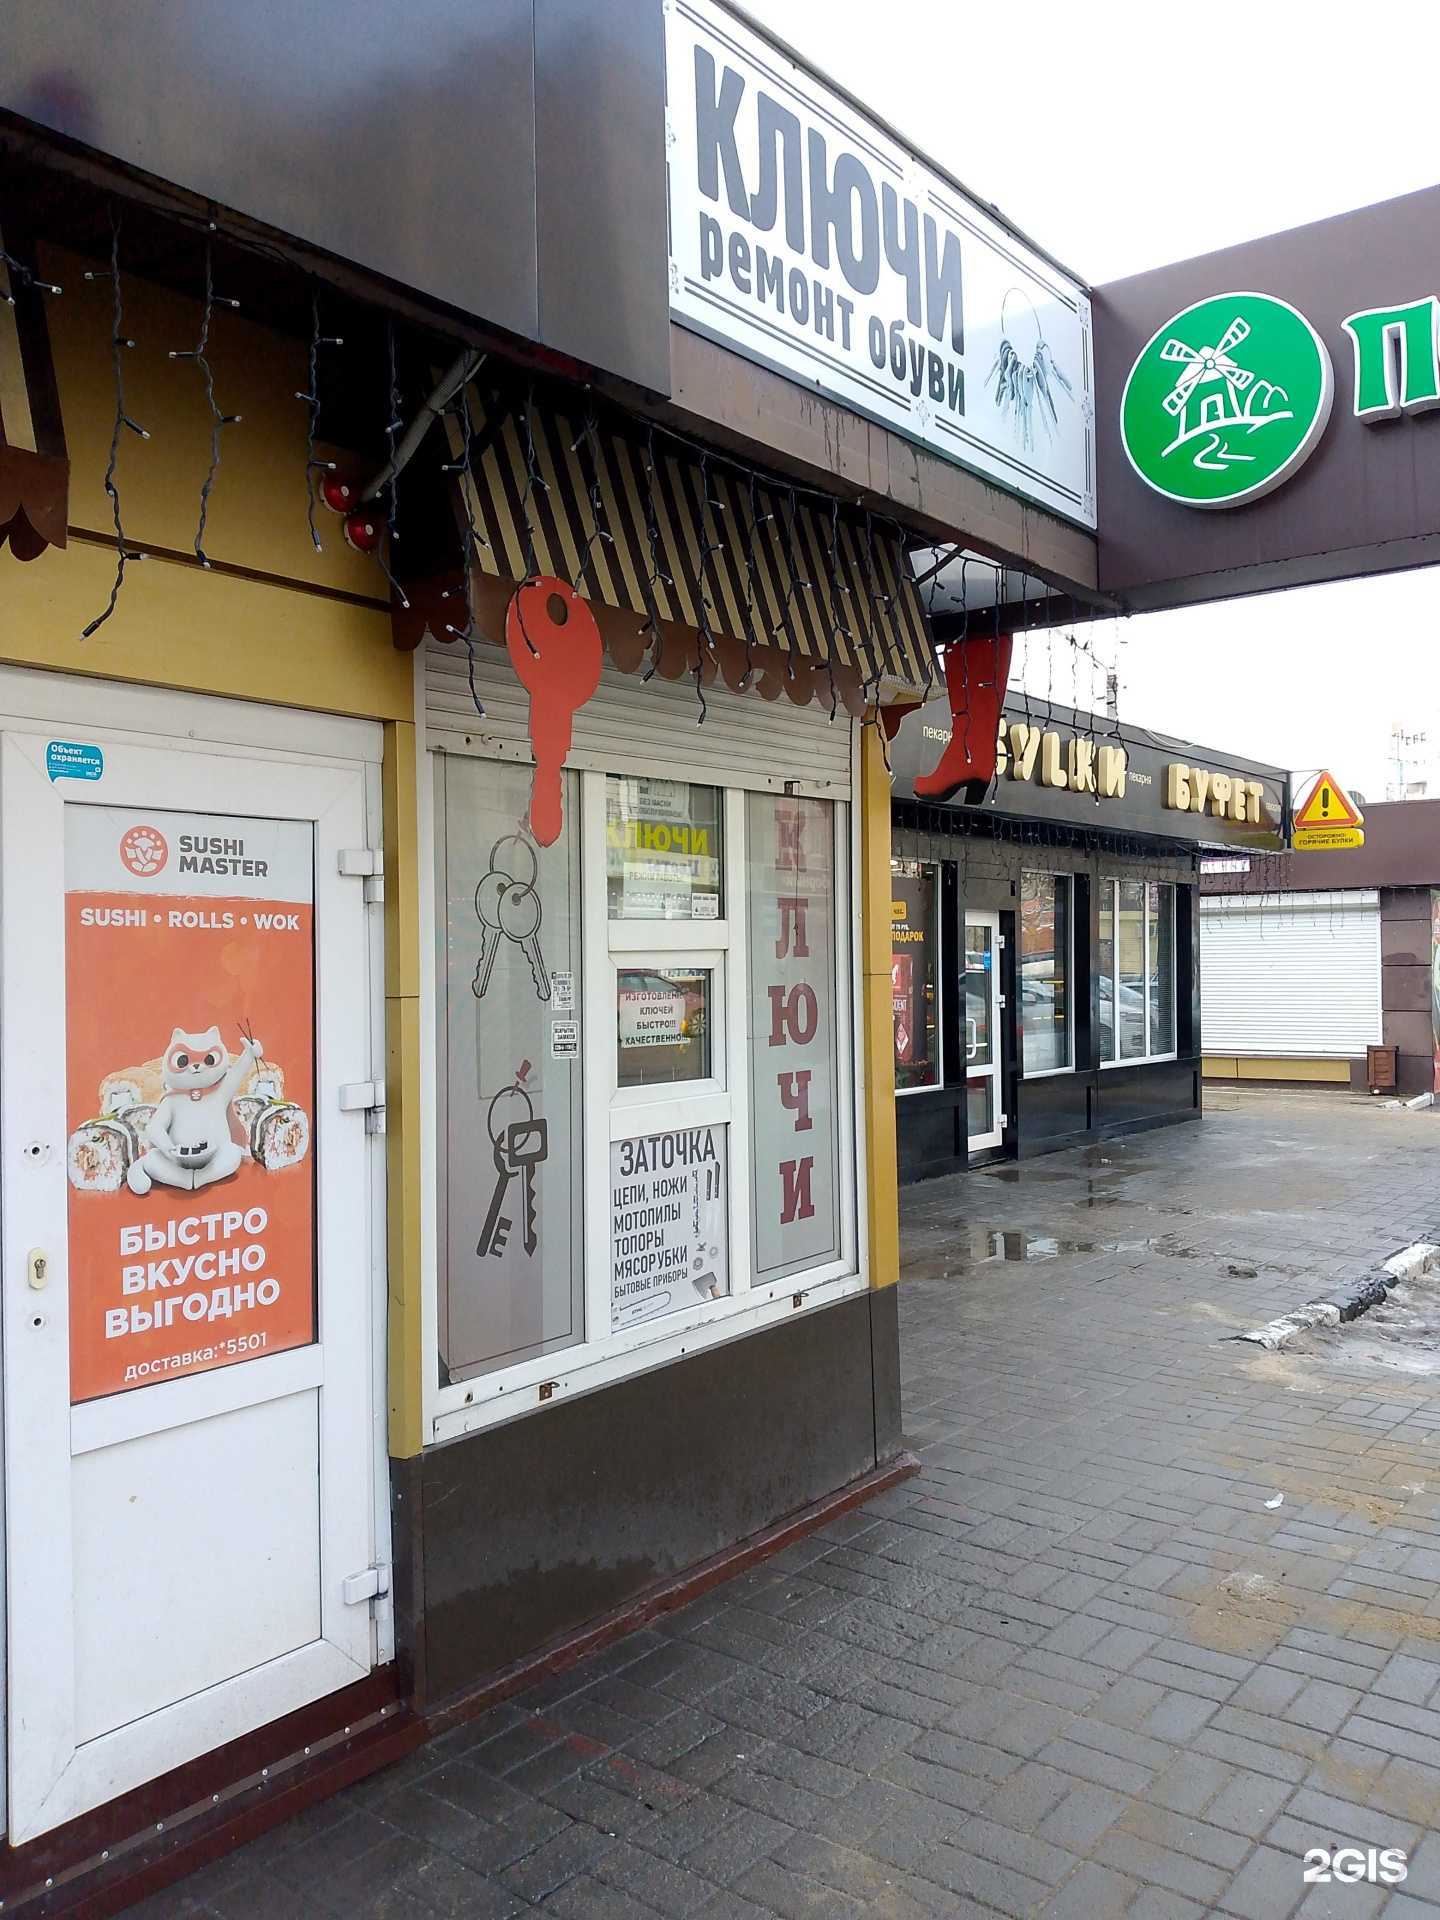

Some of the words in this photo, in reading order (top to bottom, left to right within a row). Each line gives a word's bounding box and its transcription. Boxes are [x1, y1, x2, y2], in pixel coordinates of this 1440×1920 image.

[693, 44, 965, 356] КЛЮЧИ
[700, 211, 854, 351] ремонт
[868, 314, 966, 416] обуви
[1342, 295, 1440, 416] П
[51, 744, 82, 755] Объект
[51, 754, 100, 765] охраняется
[1168, 763, 1264, 823] БУФЕТ
[179, 835, 244, 857] SUSHI
[607, 817, 708, 855] КЛЮЧИ
[178, 855, 268, 878] MASTER
[80, 908, 146, 928] SUSHI
[168, 911, 234, 929] ROLLS
[253, 914, 300, 931] WOK
[636, 1020, 676, 1030] БЫСТРО!!!
[620, 1129, 716, 1177] ЗАТОЧКА
[613, 1183, 649, 1209] ЦЕПИ,
[652, 1176, 687, 1199] НОЖИ
[120, 1207, 268, 1256] БЫСТРО
[614, 1202, 681, 1234] МОТОПИЛЫ
[615, 1228, 664, 1257] ТОПОРЫ
[122, 1244, 266, 1296] ВКУСНО
[614, 1245, 687, 1282] МЯСОРУБКИ
[614, 1278, 651, 1298] БЫТОВЫЕ
[653, 1268, 688, 1287] ПРИБОРЫ
[105, 1278, 280, 1339] ВЫГОДНО
